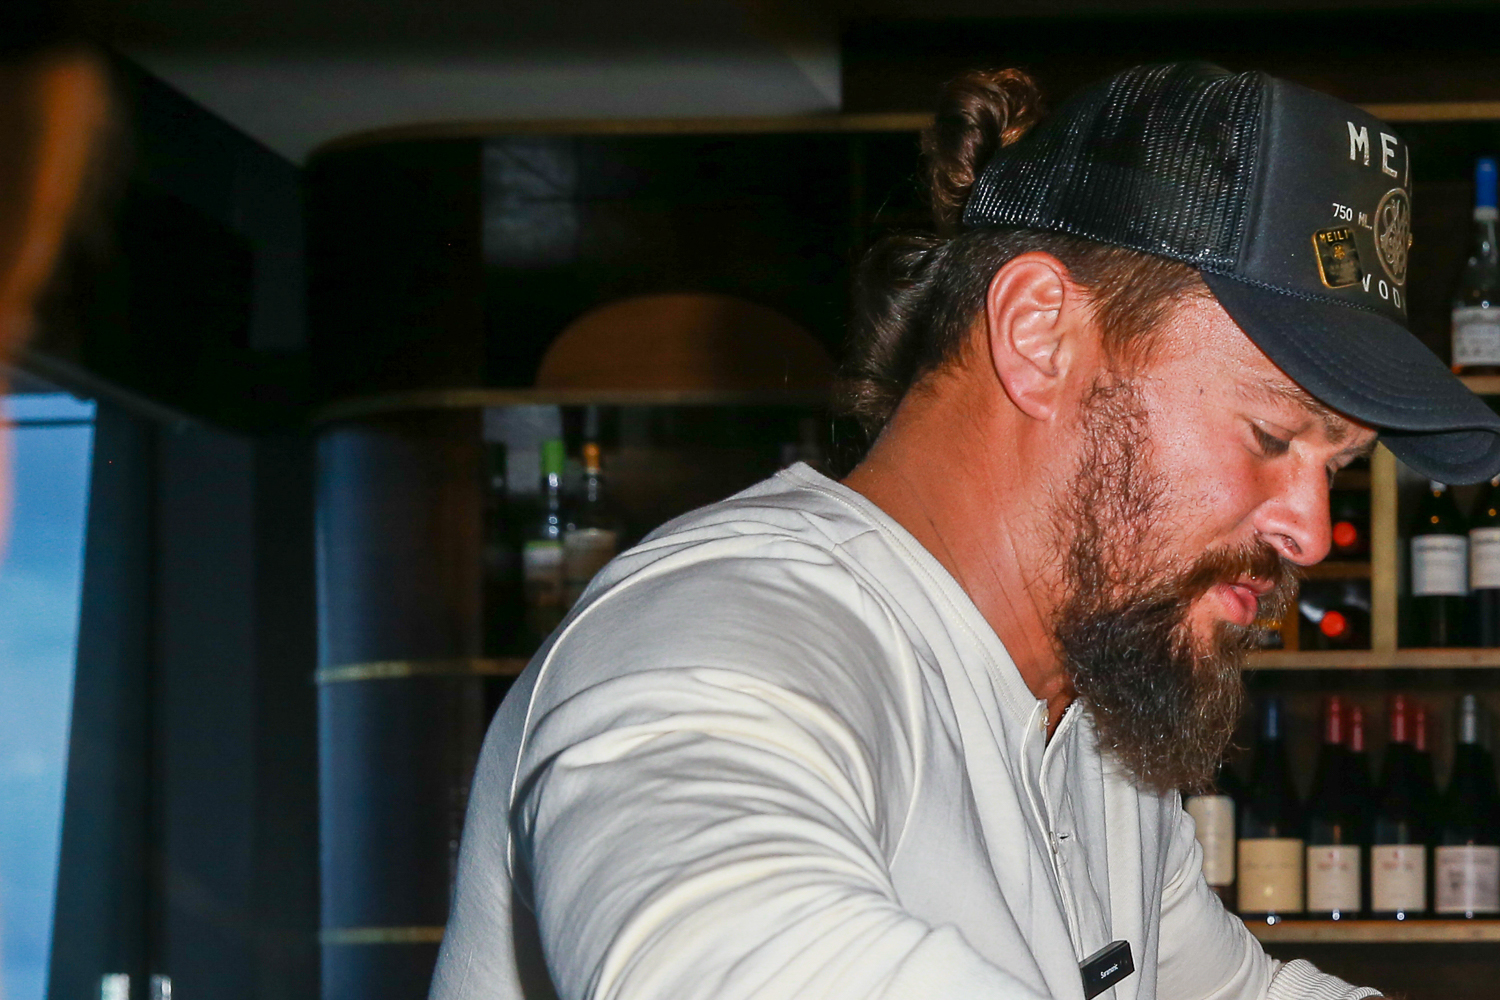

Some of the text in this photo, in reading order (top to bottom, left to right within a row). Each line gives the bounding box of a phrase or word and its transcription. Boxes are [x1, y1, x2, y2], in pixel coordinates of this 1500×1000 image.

[1332, 203, 1353, 221] 750
[1319, 229, 1348, 243] MEILI
[1362, 273, 1407, 314] VOD
